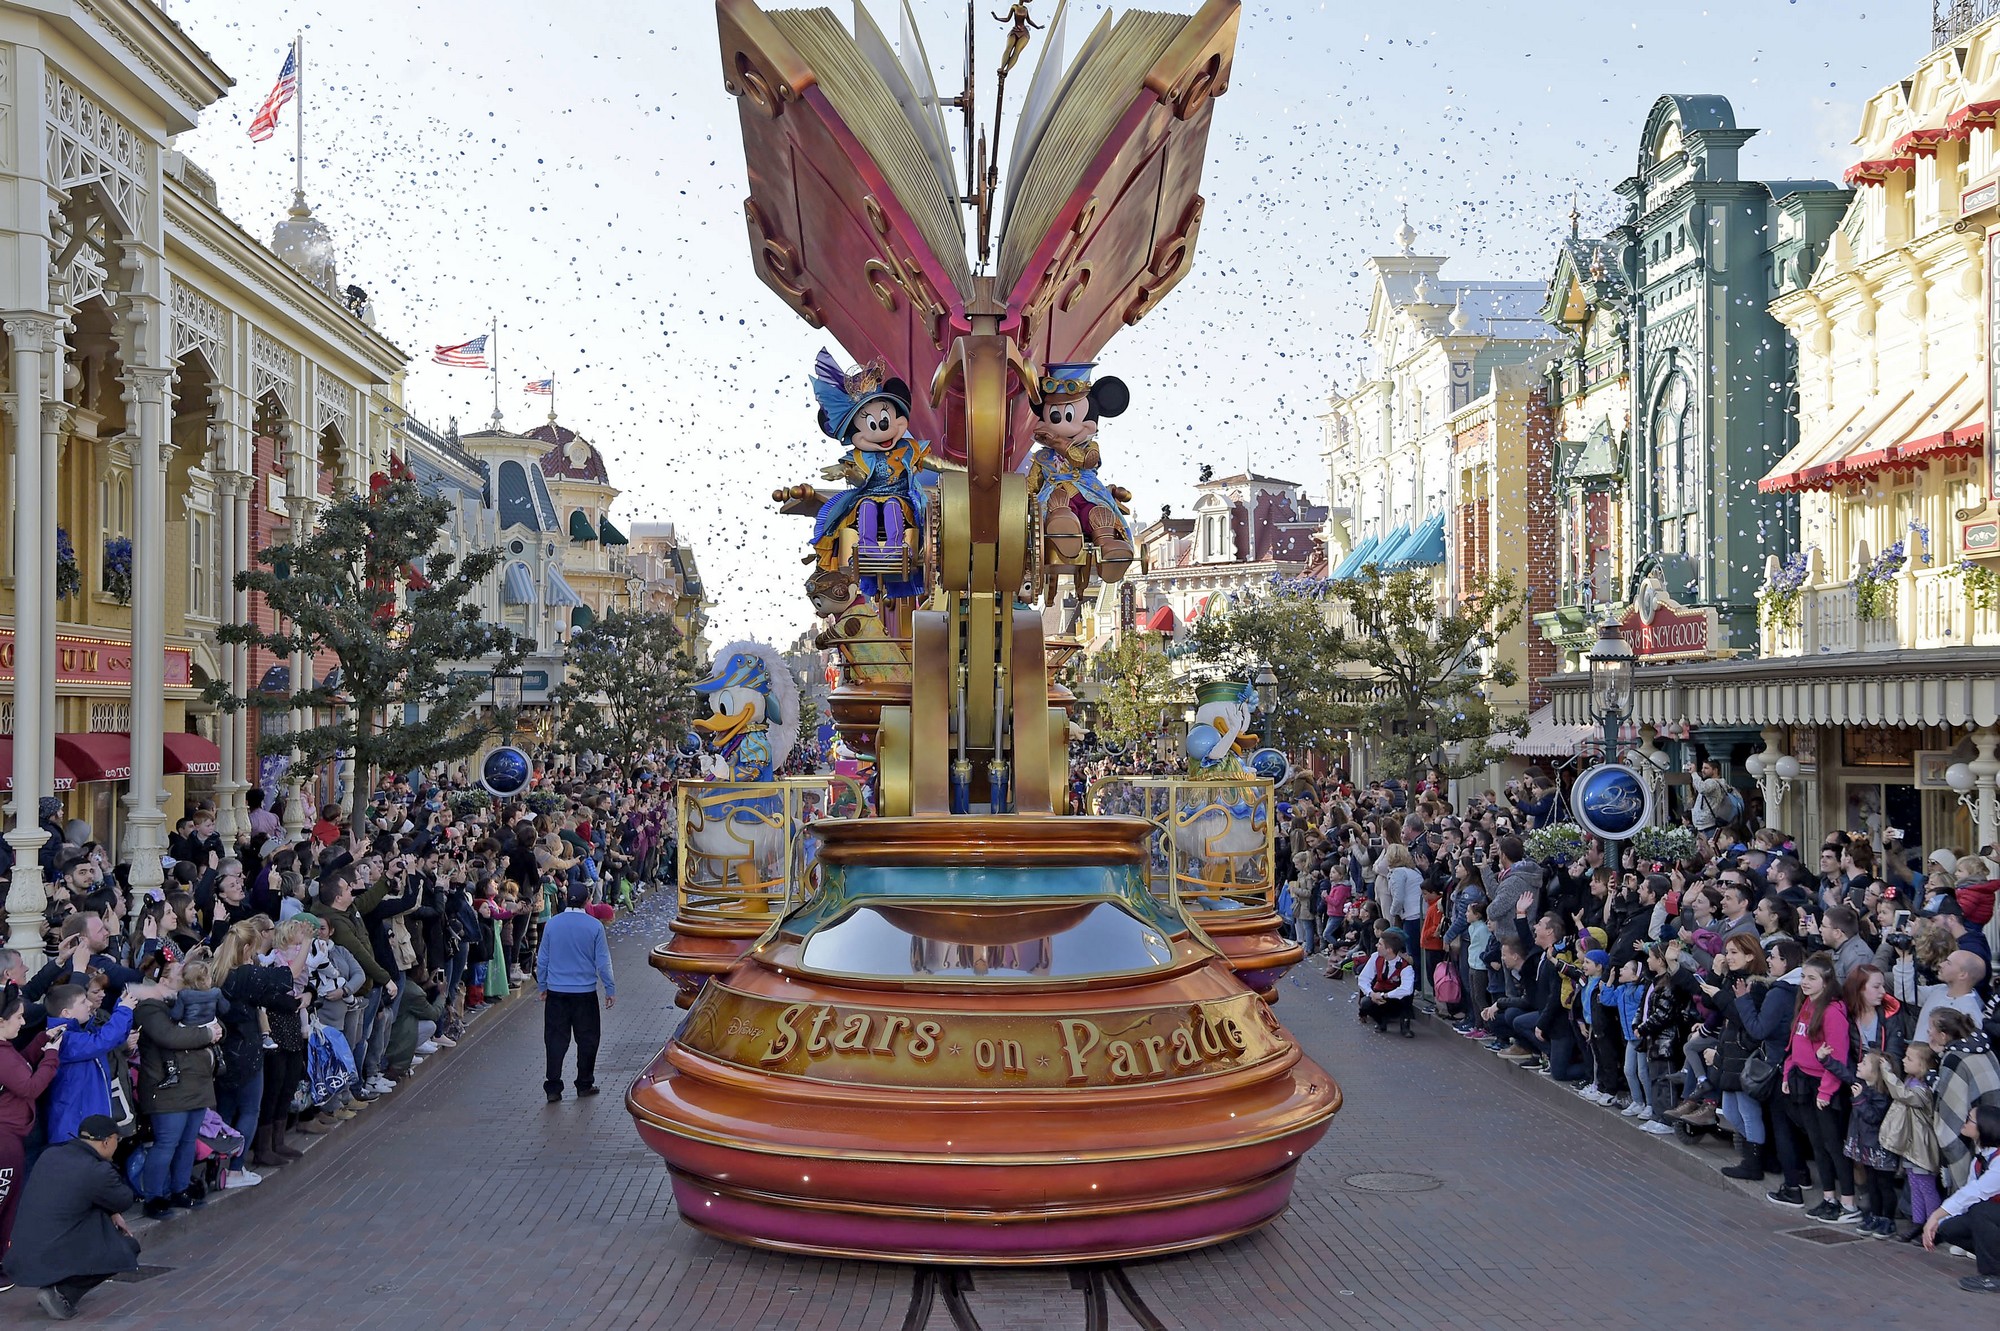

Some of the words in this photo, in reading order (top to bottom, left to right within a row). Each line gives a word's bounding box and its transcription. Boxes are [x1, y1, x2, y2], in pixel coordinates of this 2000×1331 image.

[1642, 625, 1671, 650] FANCY
[1671, 621, 1706, 647] GOODS
[760, 1002, 943, 1066] Stars
[974, 1038, 1027, 1075] on
[1056, 1003, 1248, 1086] Parade
